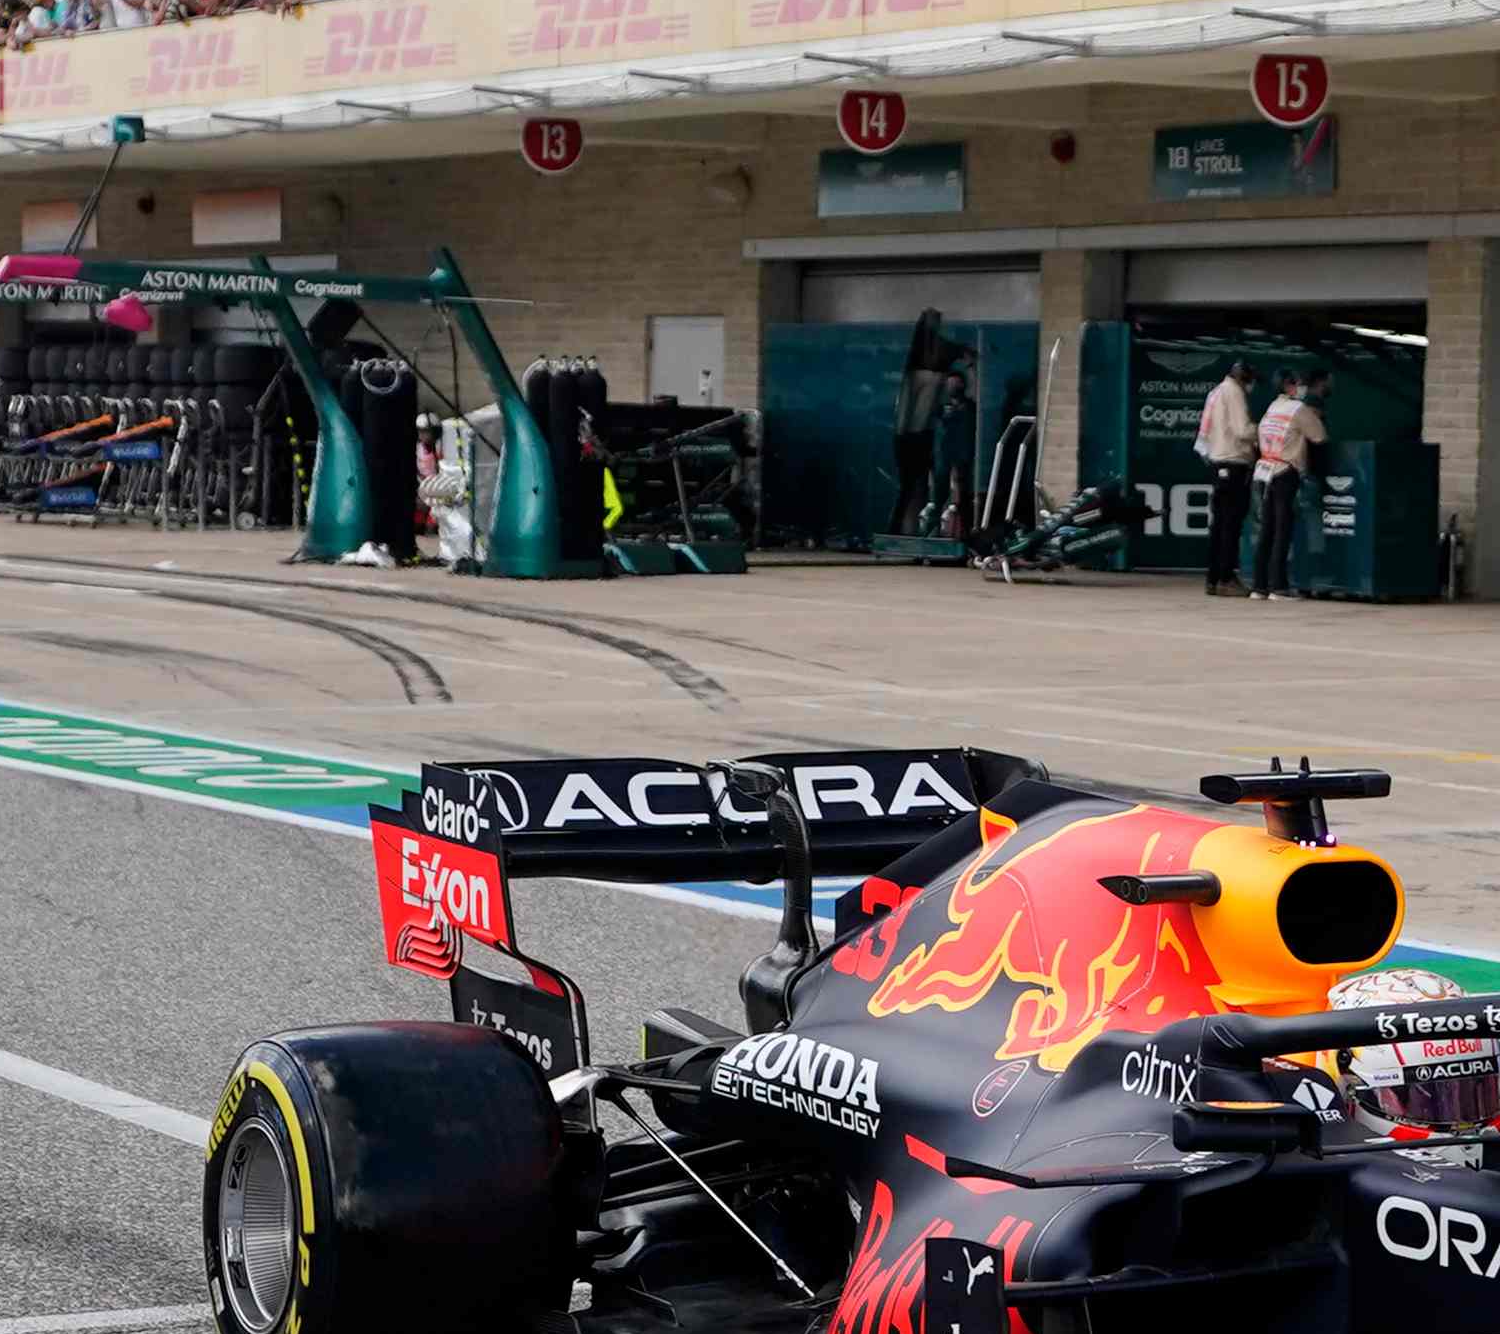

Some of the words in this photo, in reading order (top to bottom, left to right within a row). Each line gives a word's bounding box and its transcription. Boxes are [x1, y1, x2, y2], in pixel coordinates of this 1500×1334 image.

[323, 5, 436, 75] DHL
[146, 30, 246, 96] DHL
[1276, 62, 1309, 109] 15
[860, 99, 887, 138] 14
[540, 124, 566, 161] 13
[1167, 147, 1190, 169] 18
[1194, 155, 1243, 175] STROLL
[143, 270, 204, 291] ASTON
[209, 273, 279, 293] MARTIN
[295, 280, 363, 298] Cognizant
[1139, 380, 1178, 393] ASTON
[1135, 483, 1215, 536] 18
[422, 783, 482, 843] Claro
[544, 762, 977, 827] ACURA
[402, 837, 491, 930] Exxon
[1402, 1012, 1477, 1034] Tezos
[1424, 1042, 1455, 1057] Red
[1458, 1038, 1483, 1054] Bull
[721, 1031, 881, 1113] HONDA
[1123, 1043, 1197, 1105] citrix
[1432, 1060, 1493, 1079] ACURA
[1316, 1111, 1342, 1122] TER
